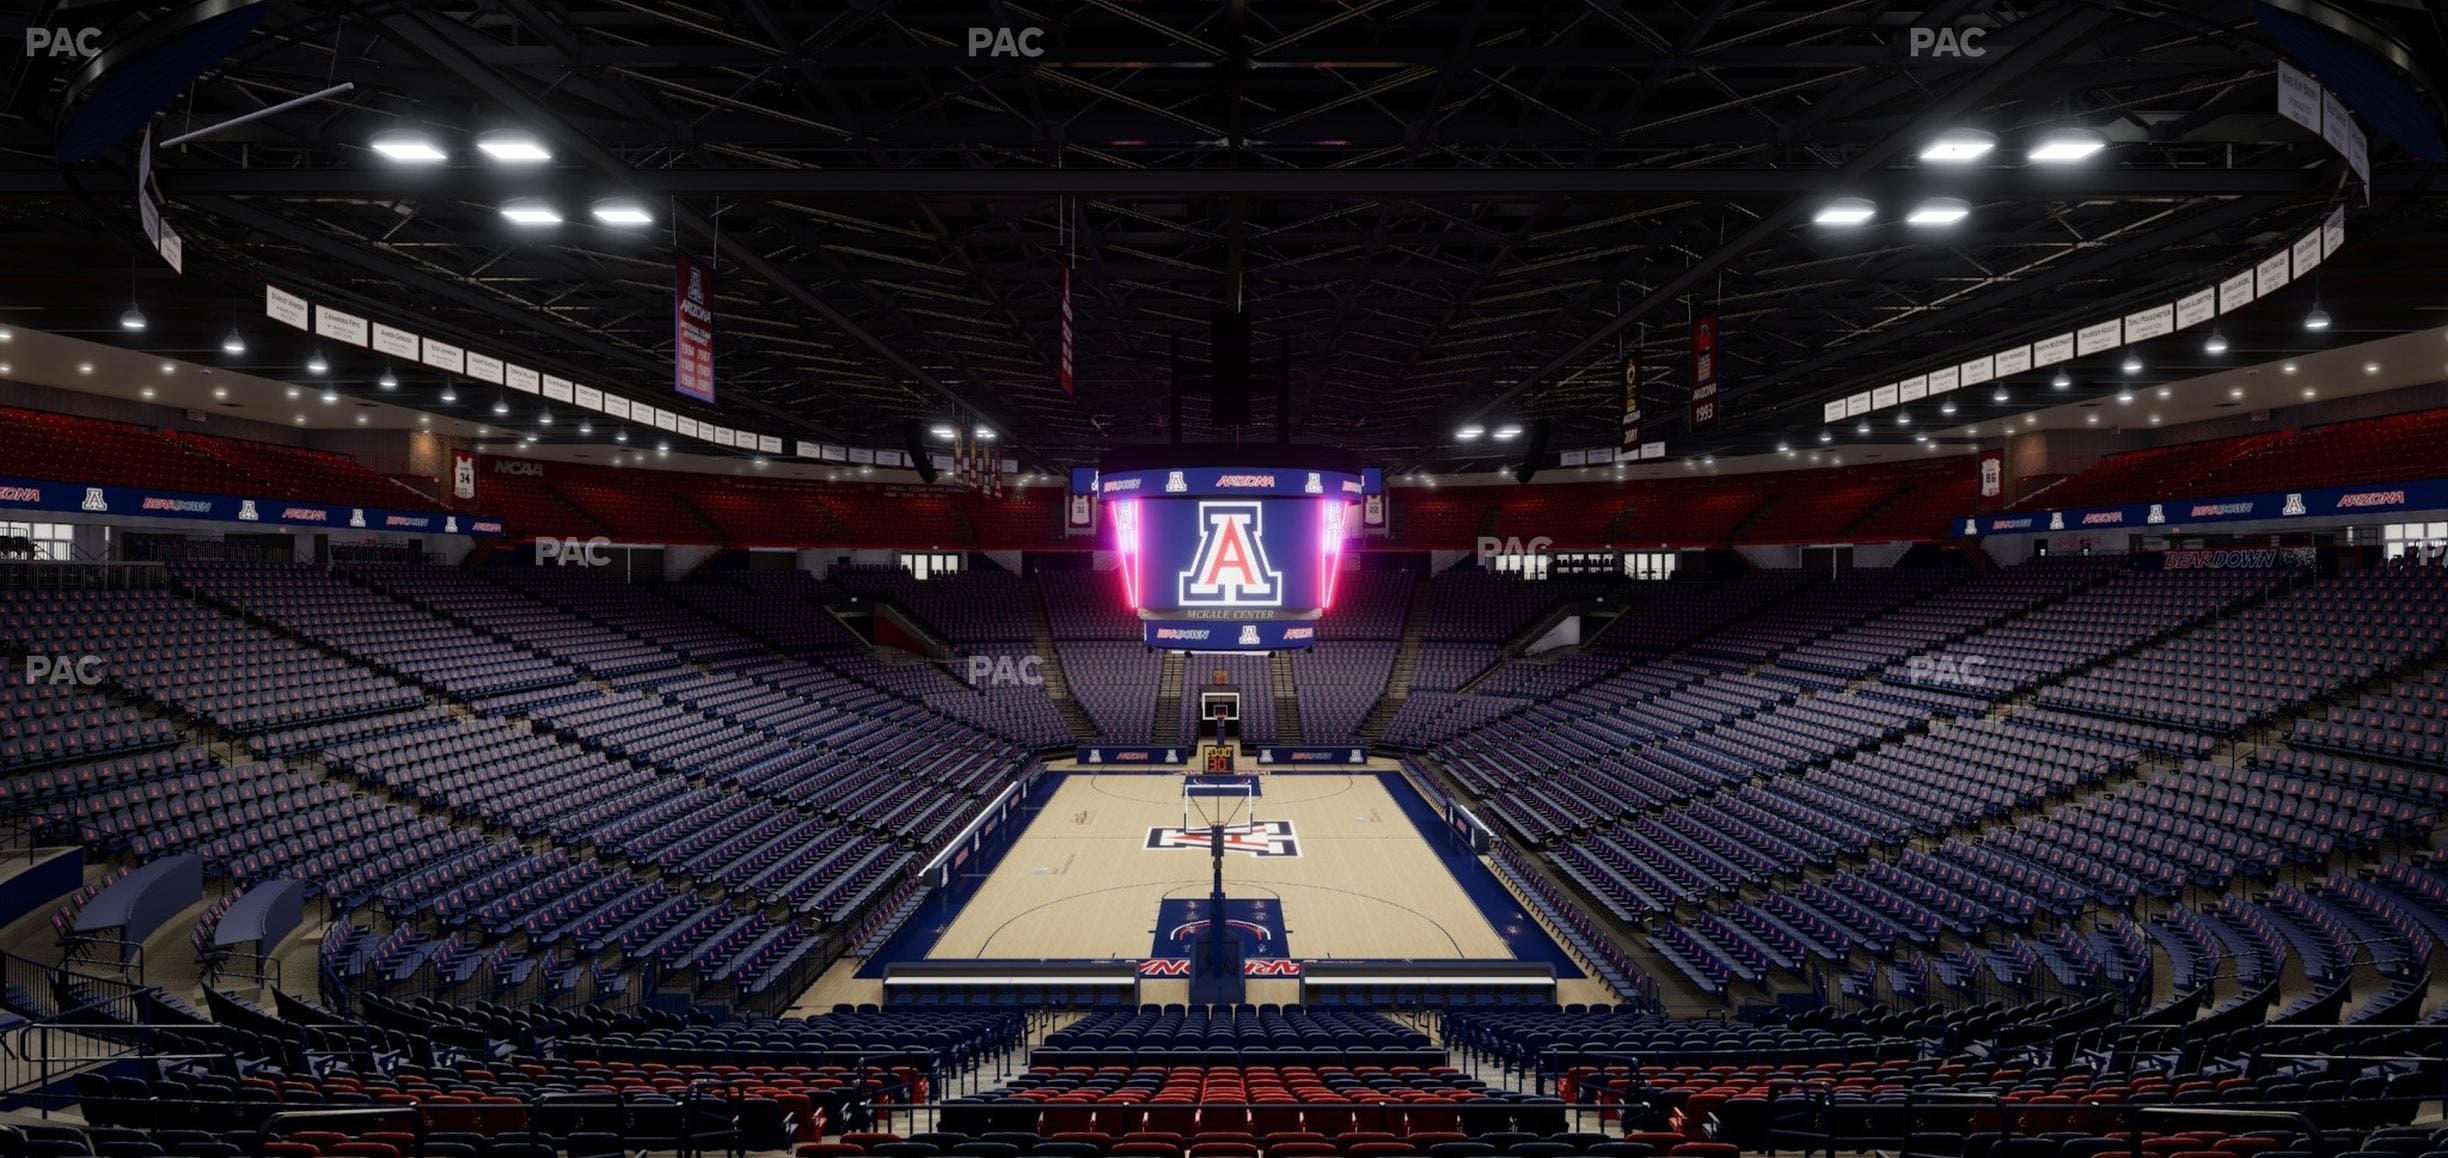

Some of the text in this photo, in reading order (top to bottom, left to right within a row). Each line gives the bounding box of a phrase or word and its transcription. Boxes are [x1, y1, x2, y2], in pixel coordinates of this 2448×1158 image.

[680, 299, 711, 323] ARIZONA
[1692, 383, 1717, 400] ARIZONA
[1696, 403, 1713, 422] 1993
[495, 460, 544, 477] NCAA
[460, 472, 470, 484] 34
[1216, 475, 1275, 488] ARIZONA
[0, 486, 40, 502] ZONA
[82, 487, 108, 511] A
[2337, 491, 2404, 508] ARIZONA
[238, 500, 259, 521] A
[1076, 506, 1085, 514] 31
[2282, 493, 2306, 516] A
[281, 507, 327, 521] ARIZONA
[2082, 511, 2123, 524] ARIZONA
[1179, 500, 1283, 606] A
[1187, 610, 1274, 619] MCKALE CENTER
